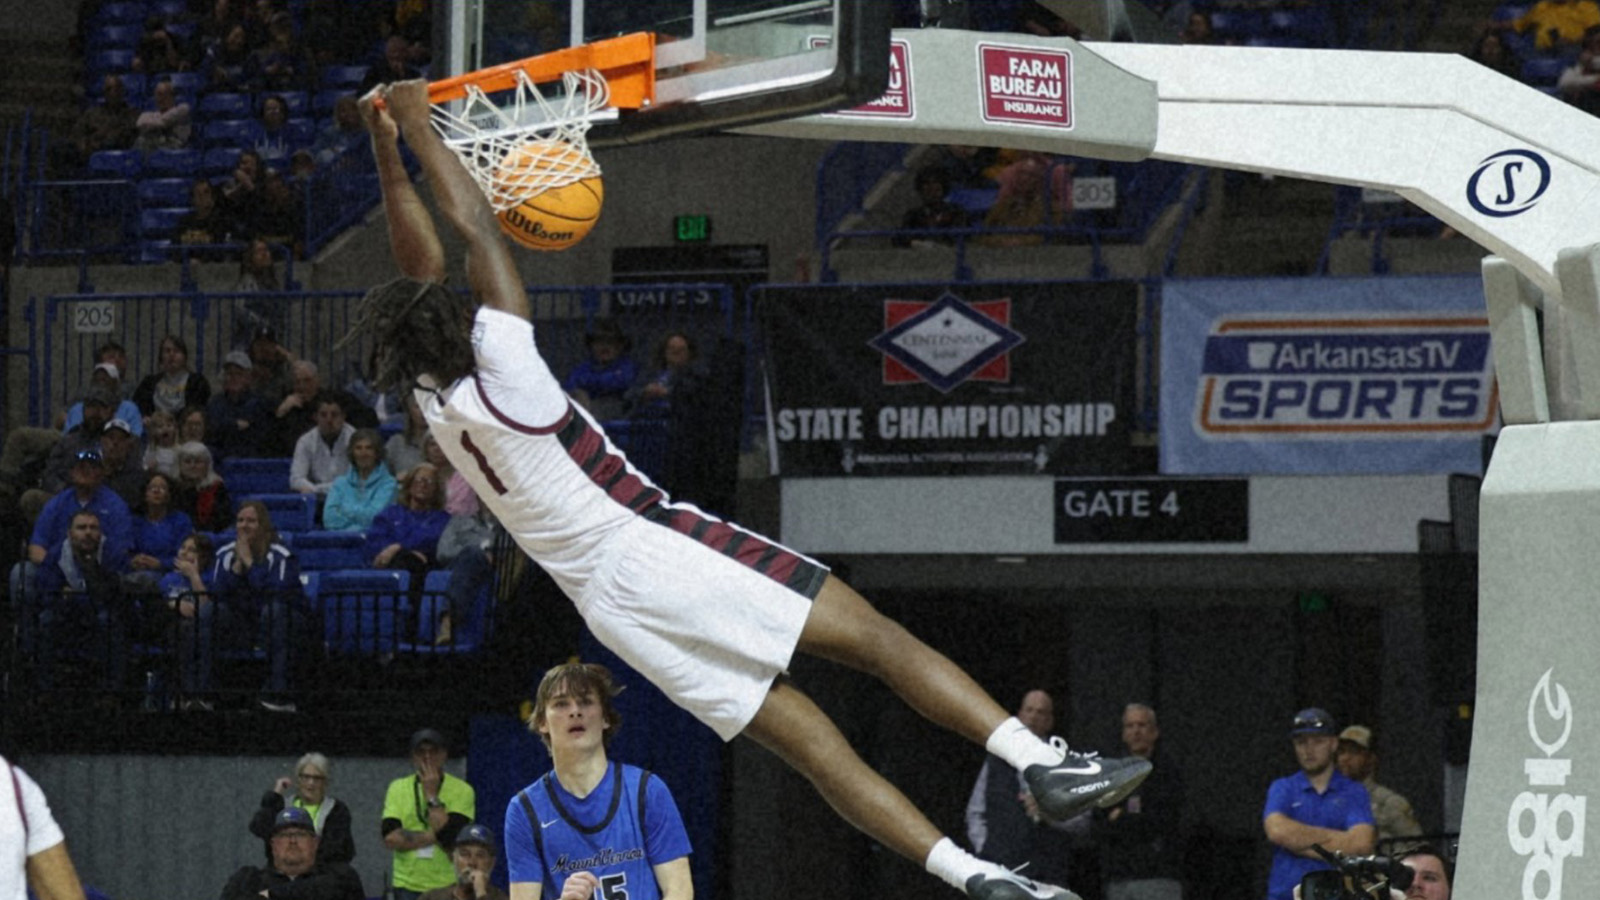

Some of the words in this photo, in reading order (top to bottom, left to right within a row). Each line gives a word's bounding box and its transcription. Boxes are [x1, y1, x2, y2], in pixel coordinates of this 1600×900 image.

[1009, 57, 1060, 79] FARM
[989, 75, 1062, 99] BUREAU
[1003, 101, 1063, 117] INSURANCE
[1075, 183, 1112, 203] 305
[505, 208, 574, 242] Wilson
[77, 306, 112, 327] 205
[1277, 340, 1461, 369] ArkansasTV
[1219, 378, 1481, 420] SPORTS
[777, 407, 863, 441] STATE
[878, 402, 1116, 439] CHAMPIONSHIP
[461, 430, 508, 496] 1
[1064, 490, 1149, 518] GATE
[1160, 490, 1181, 517] 4
